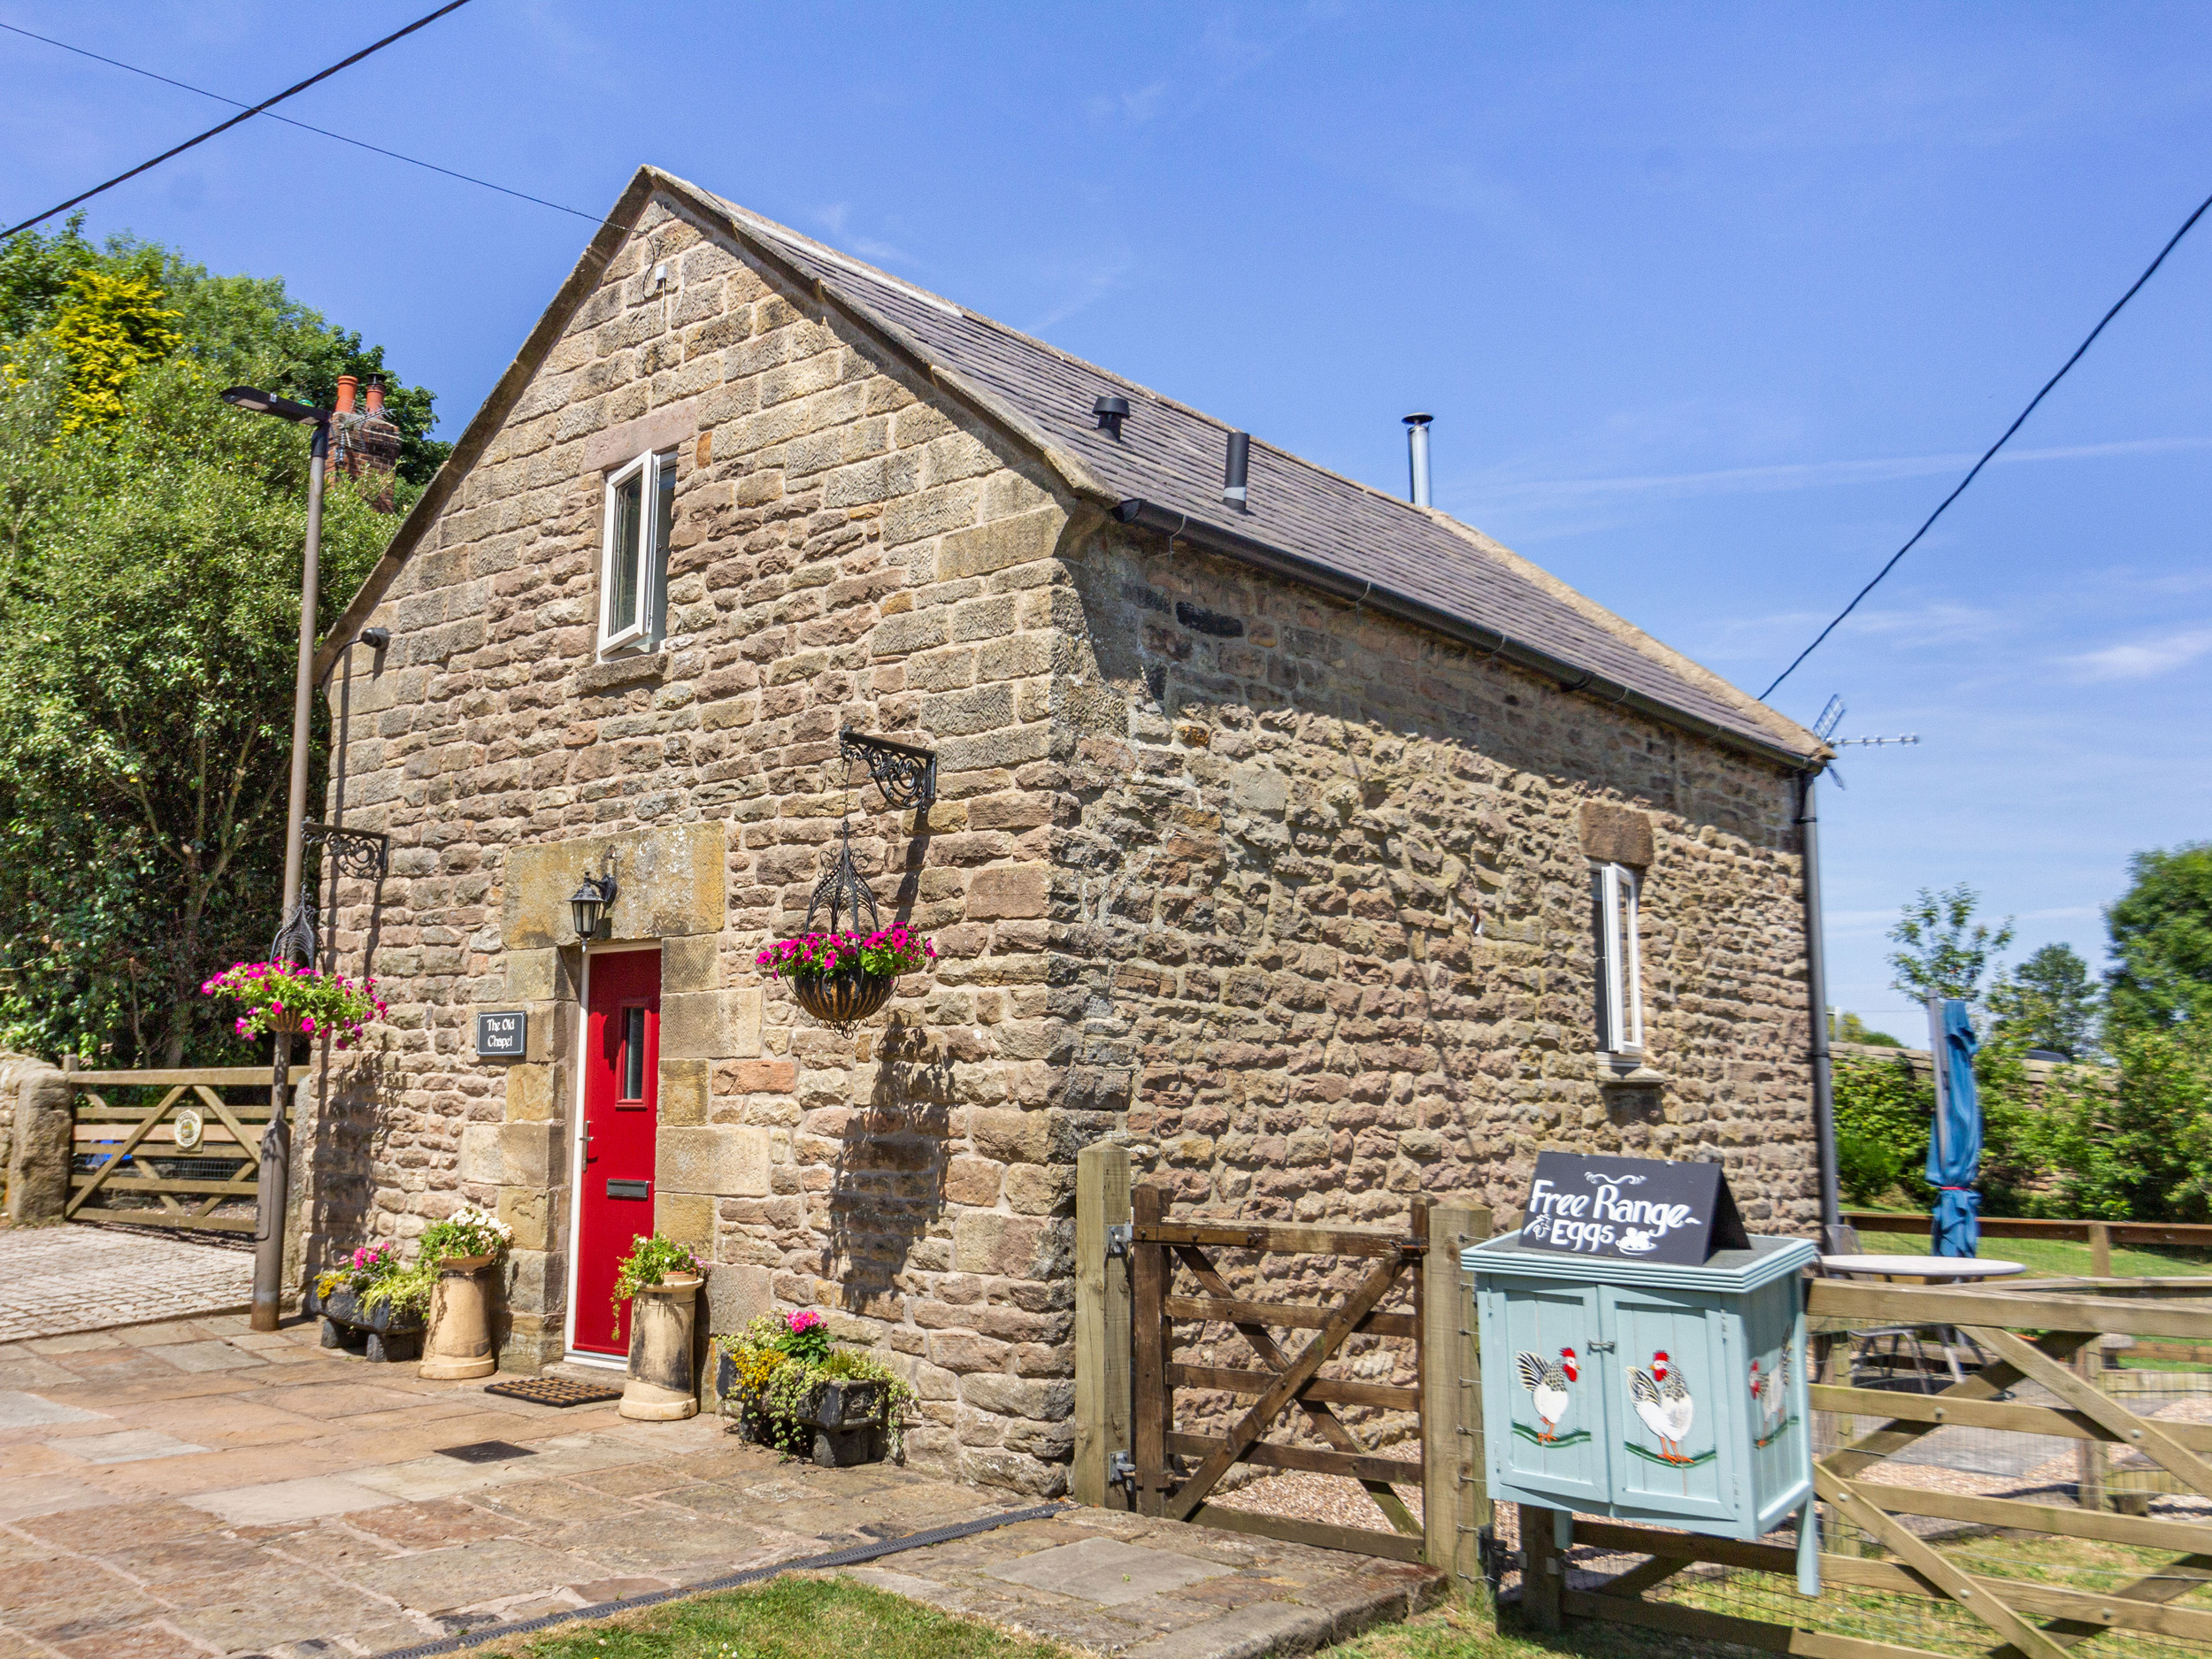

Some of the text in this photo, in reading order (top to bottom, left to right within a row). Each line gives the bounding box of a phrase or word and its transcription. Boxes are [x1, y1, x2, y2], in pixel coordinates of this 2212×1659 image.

[487, 1018, 515, 1032] The Old
[488, 1034, 512, 1049] Chapel
[1529, 1179, 1692, 1238] Free Range
[1550, 1218, 1616, 1252] Eggs
